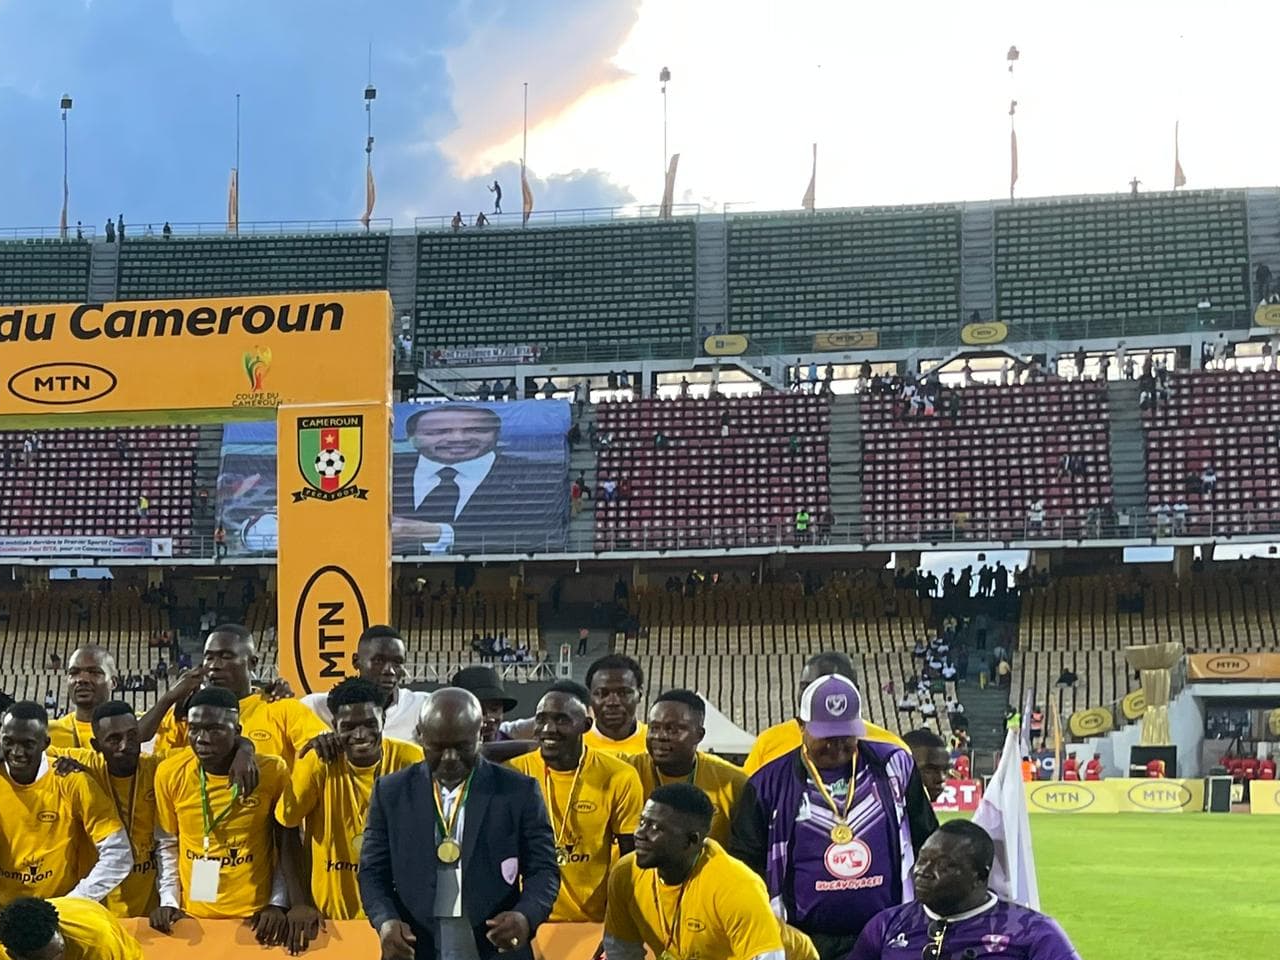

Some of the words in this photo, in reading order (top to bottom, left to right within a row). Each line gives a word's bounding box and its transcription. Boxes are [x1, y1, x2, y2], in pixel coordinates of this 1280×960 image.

[69, 301, 344, 340] Cameroun
[33, 375, 90, 392] MTN
[302, 417, 359, 428] CAMEROUN
[318, 602, 345, 678] MTN
[1216, 661, 1240, 669] MTN
[1046, 792, 1079, 803] MTN
[1143, 791, 1177, 801] MTN
[186, 849, 254, 868] Chpion
